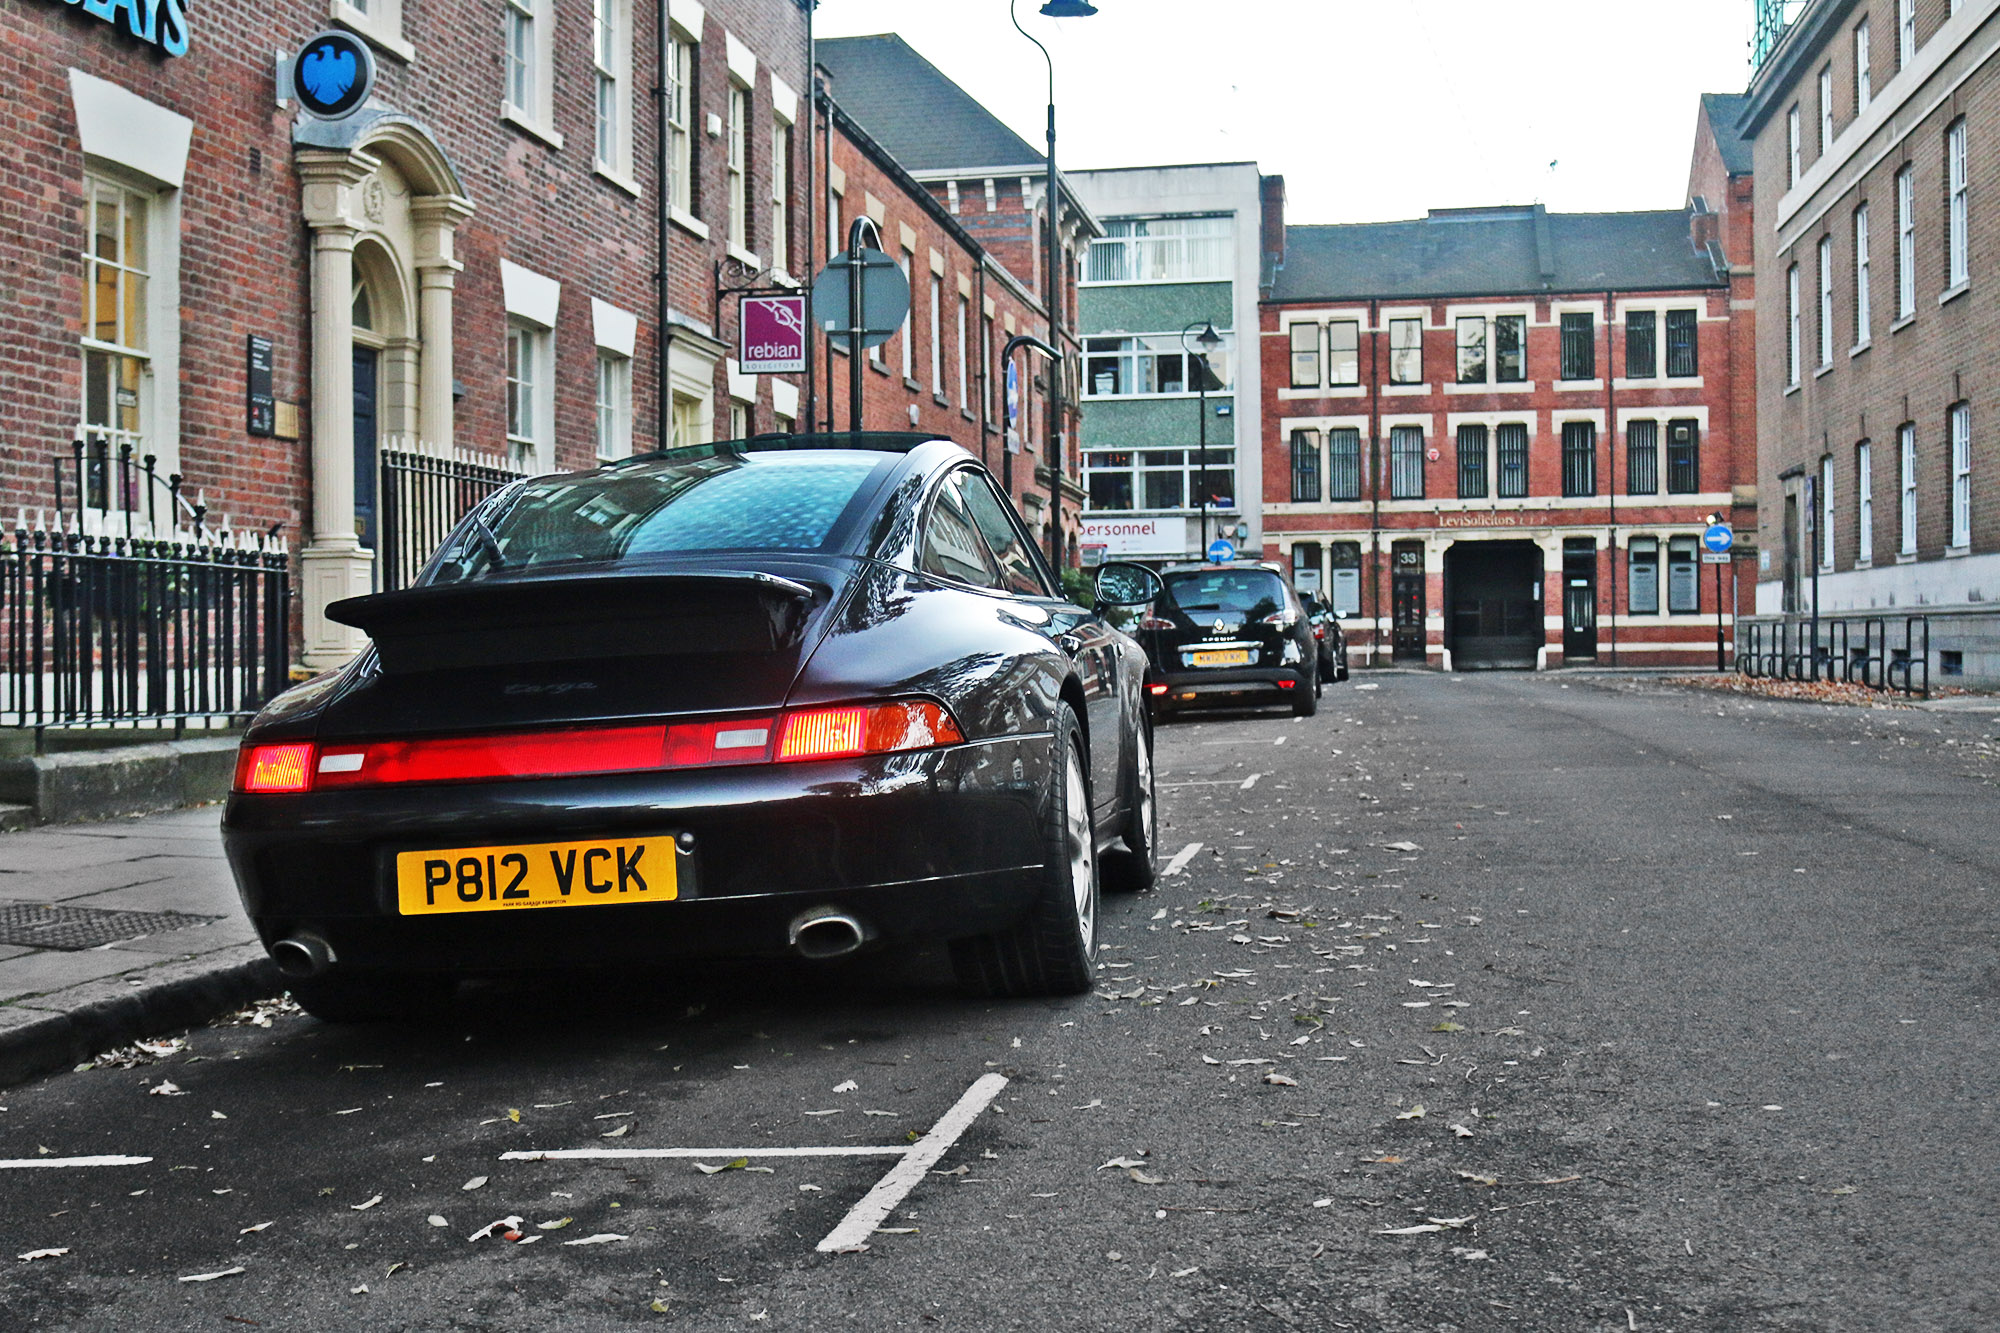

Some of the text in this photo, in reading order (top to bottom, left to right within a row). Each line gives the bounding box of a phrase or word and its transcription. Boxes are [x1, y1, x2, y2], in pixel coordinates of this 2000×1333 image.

[748, 341, 798, 359] rebian
[1400, 552, 1417, 564] 33
[424, 845, 647, 905] P812 VCK
